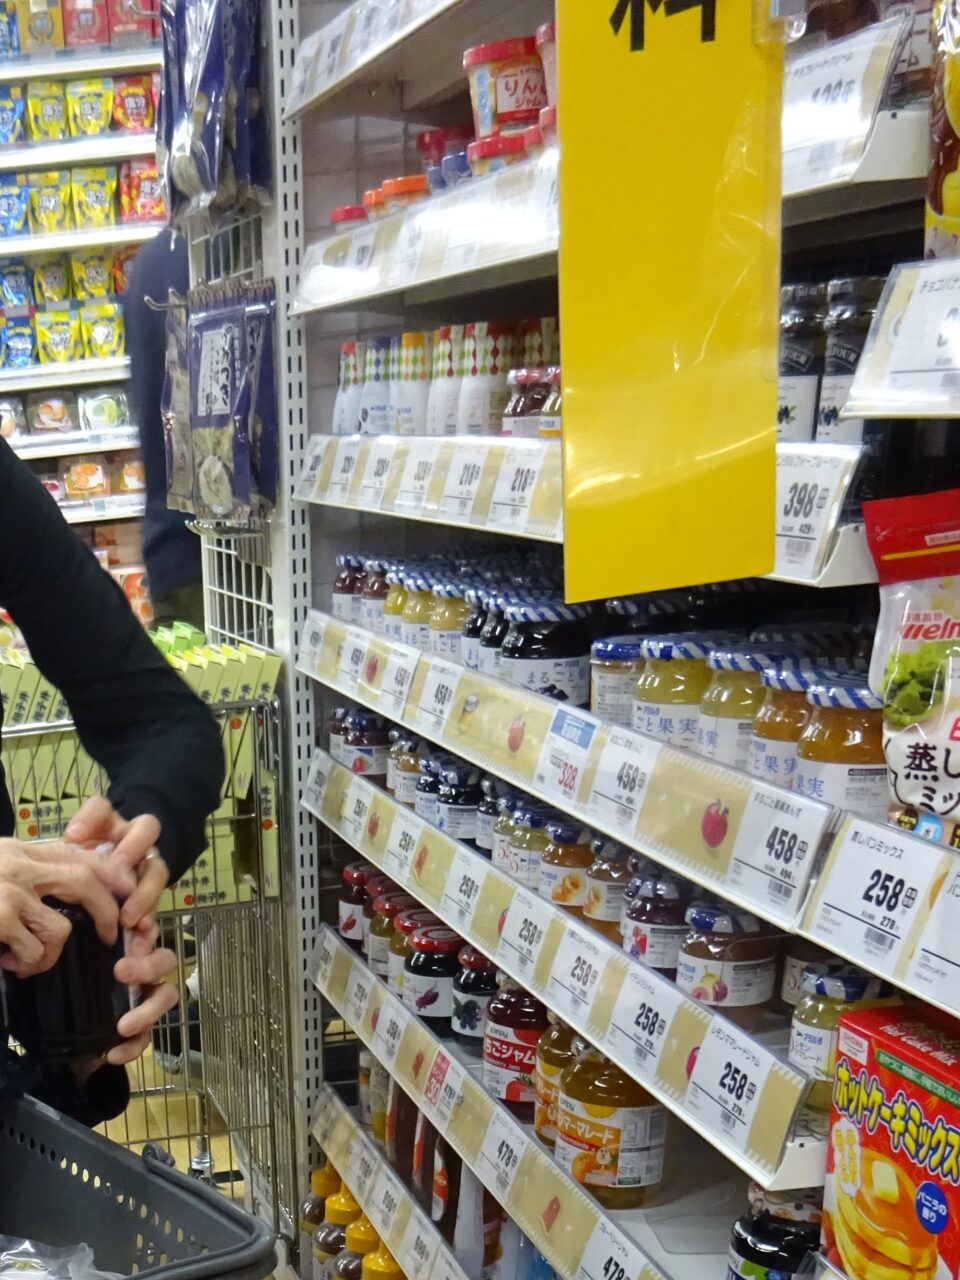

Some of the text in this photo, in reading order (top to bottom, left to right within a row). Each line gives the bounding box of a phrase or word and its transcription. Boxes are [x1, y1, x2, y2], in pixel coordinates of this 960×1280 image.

[783, 482, 819, 519] 398
[558, 761, 579, 791] 328
[616, 762, 640, 793] 458
[765, 826, 798, 865] 458
[850, 829, 905, 860] 蒸しパンミックス
[458, 875, 476, 899] 258
[862, 868, 906, 912] 258
[519, 918, 537, 946] 258
[879, 914, 897, 931] 278
[570, 955, 592, 987] 258
[634, 1002, 659, 1036] 258
[880, 1024, 898, 1036] Hot
[932, 1050, 958, 1066] Mix
[718, 1061, 748, 1101] 258
[557, 1113, 615, 1145] マーマレード
[833, 1057, 960, 1187] ホットケーキミックス
[497, 1139, 513, 1167] 478
[917, 1189, 947, 1216] バニラの
